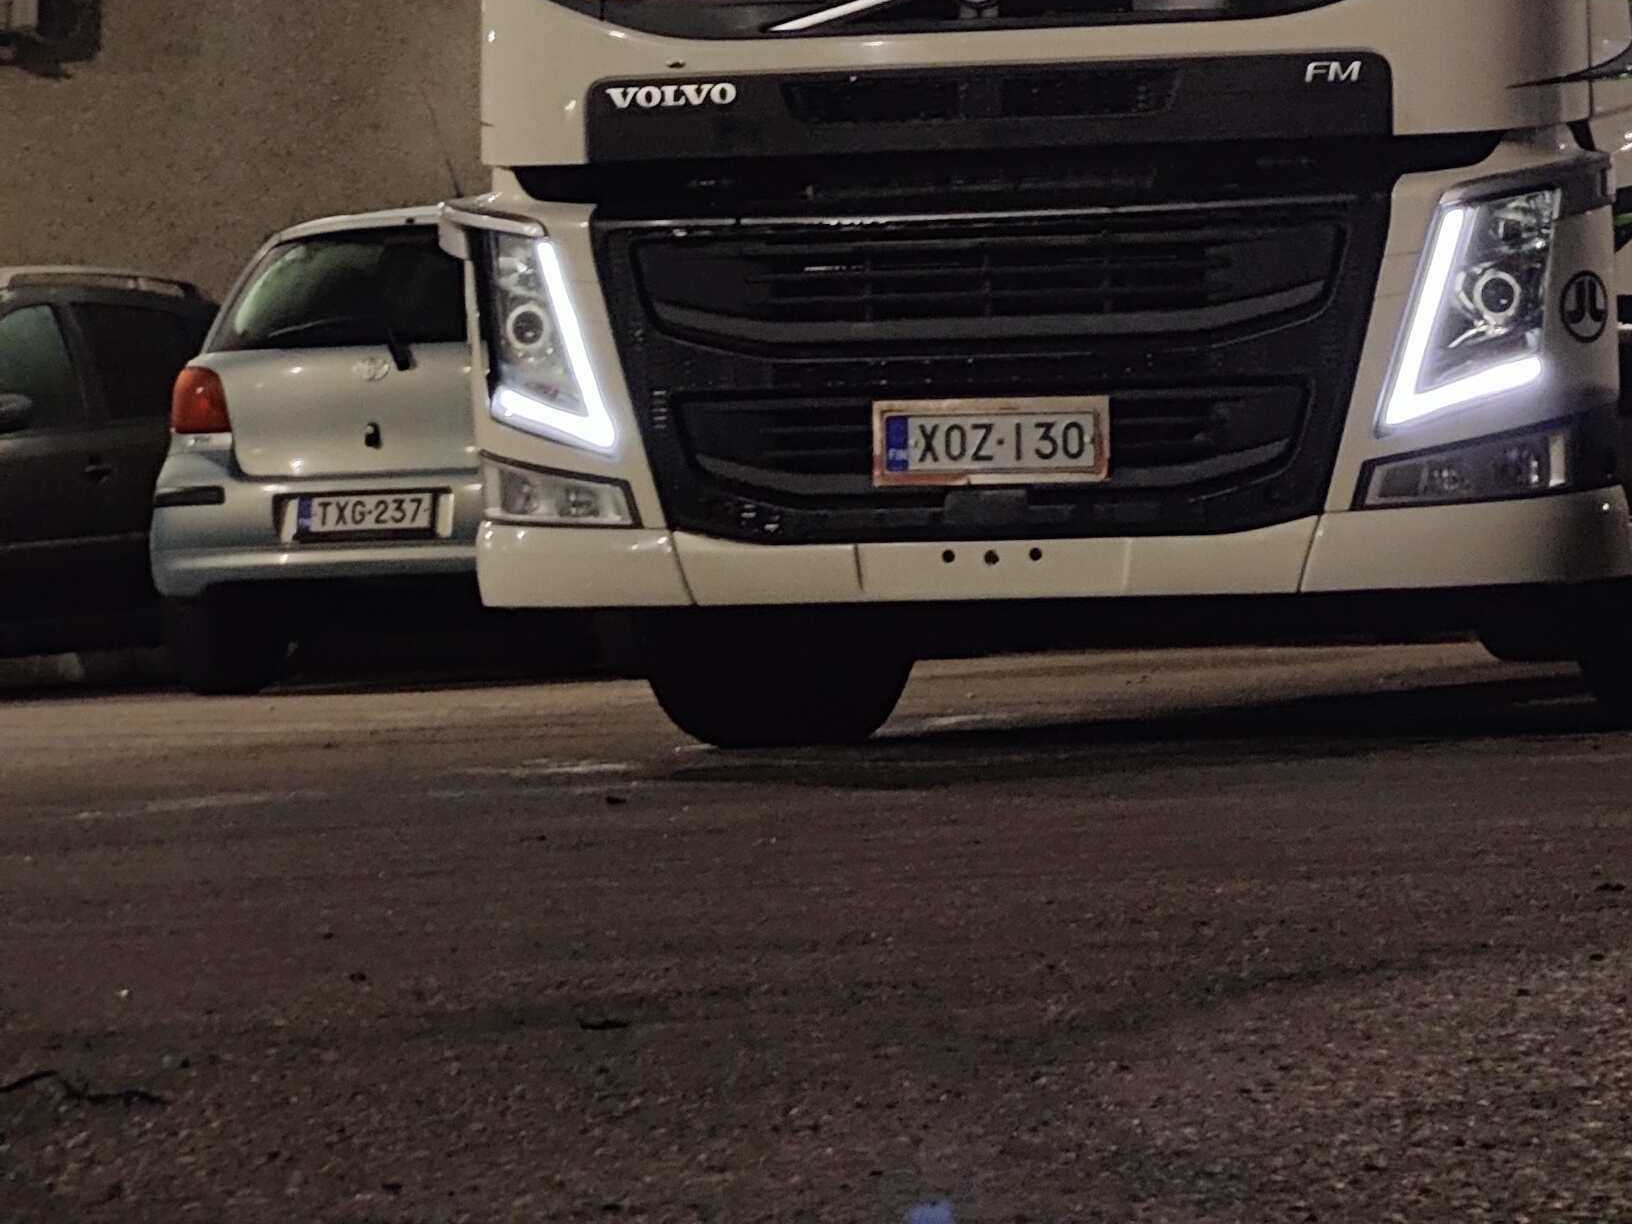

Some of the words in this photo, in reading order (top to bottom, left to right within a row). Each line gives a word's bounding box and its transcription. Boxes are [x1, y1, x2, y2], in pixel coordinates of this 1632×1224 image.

[1304, 60, 1362, 83] FM
[605, 82, 737, 109] VOLVO
[917, 421, 1086, 464] XOZ-130
[318, 498, 424, 527] TXG-237
